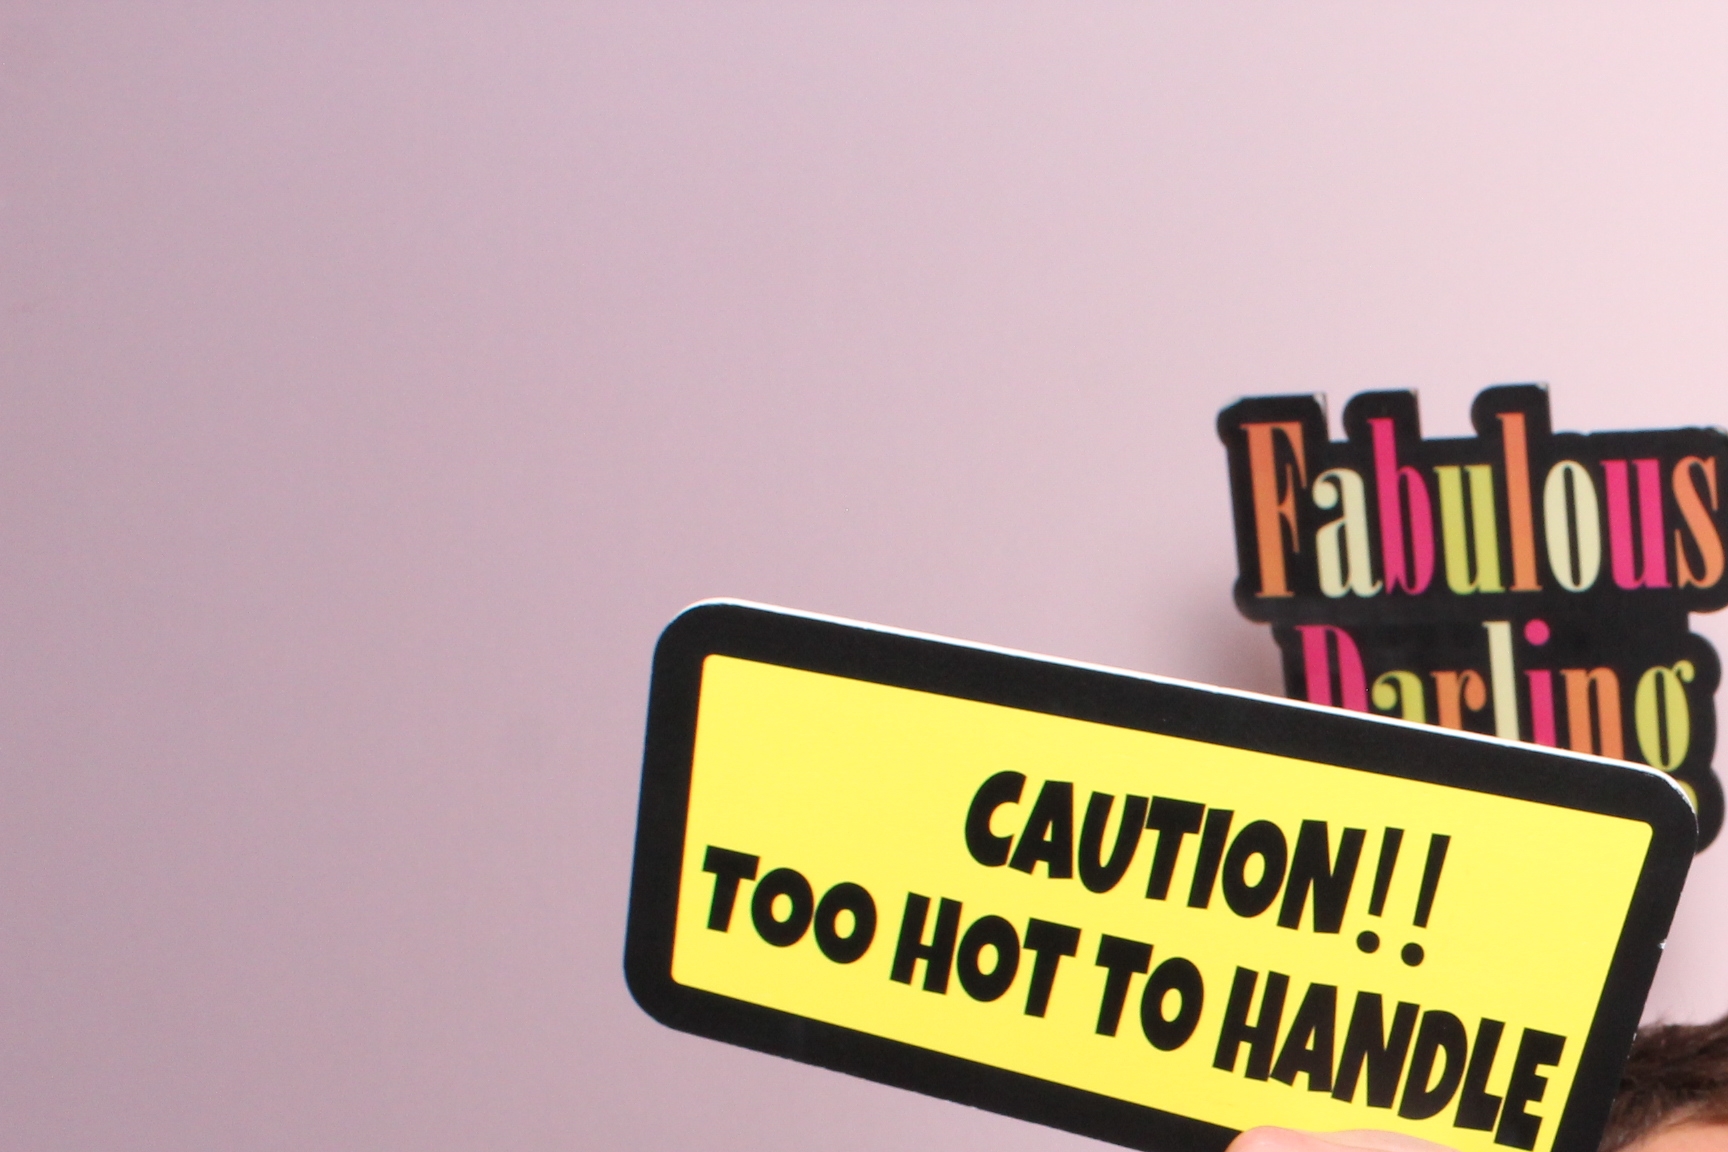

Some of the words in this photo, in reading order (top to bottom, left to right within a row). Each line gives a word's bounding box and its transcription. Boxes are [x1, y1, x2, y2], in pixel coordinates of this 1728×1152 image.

[1240, 412, 1726, 599] Fabulous
[964, 770, 1451, 967] CAUTION!!
[702, 845, 877, 965] TOO
[890, 892, 1082, 1018] HOT
[1095, 933, 1204, 1052] TO
[1212, 966, 1567, 1152] HANDLE
